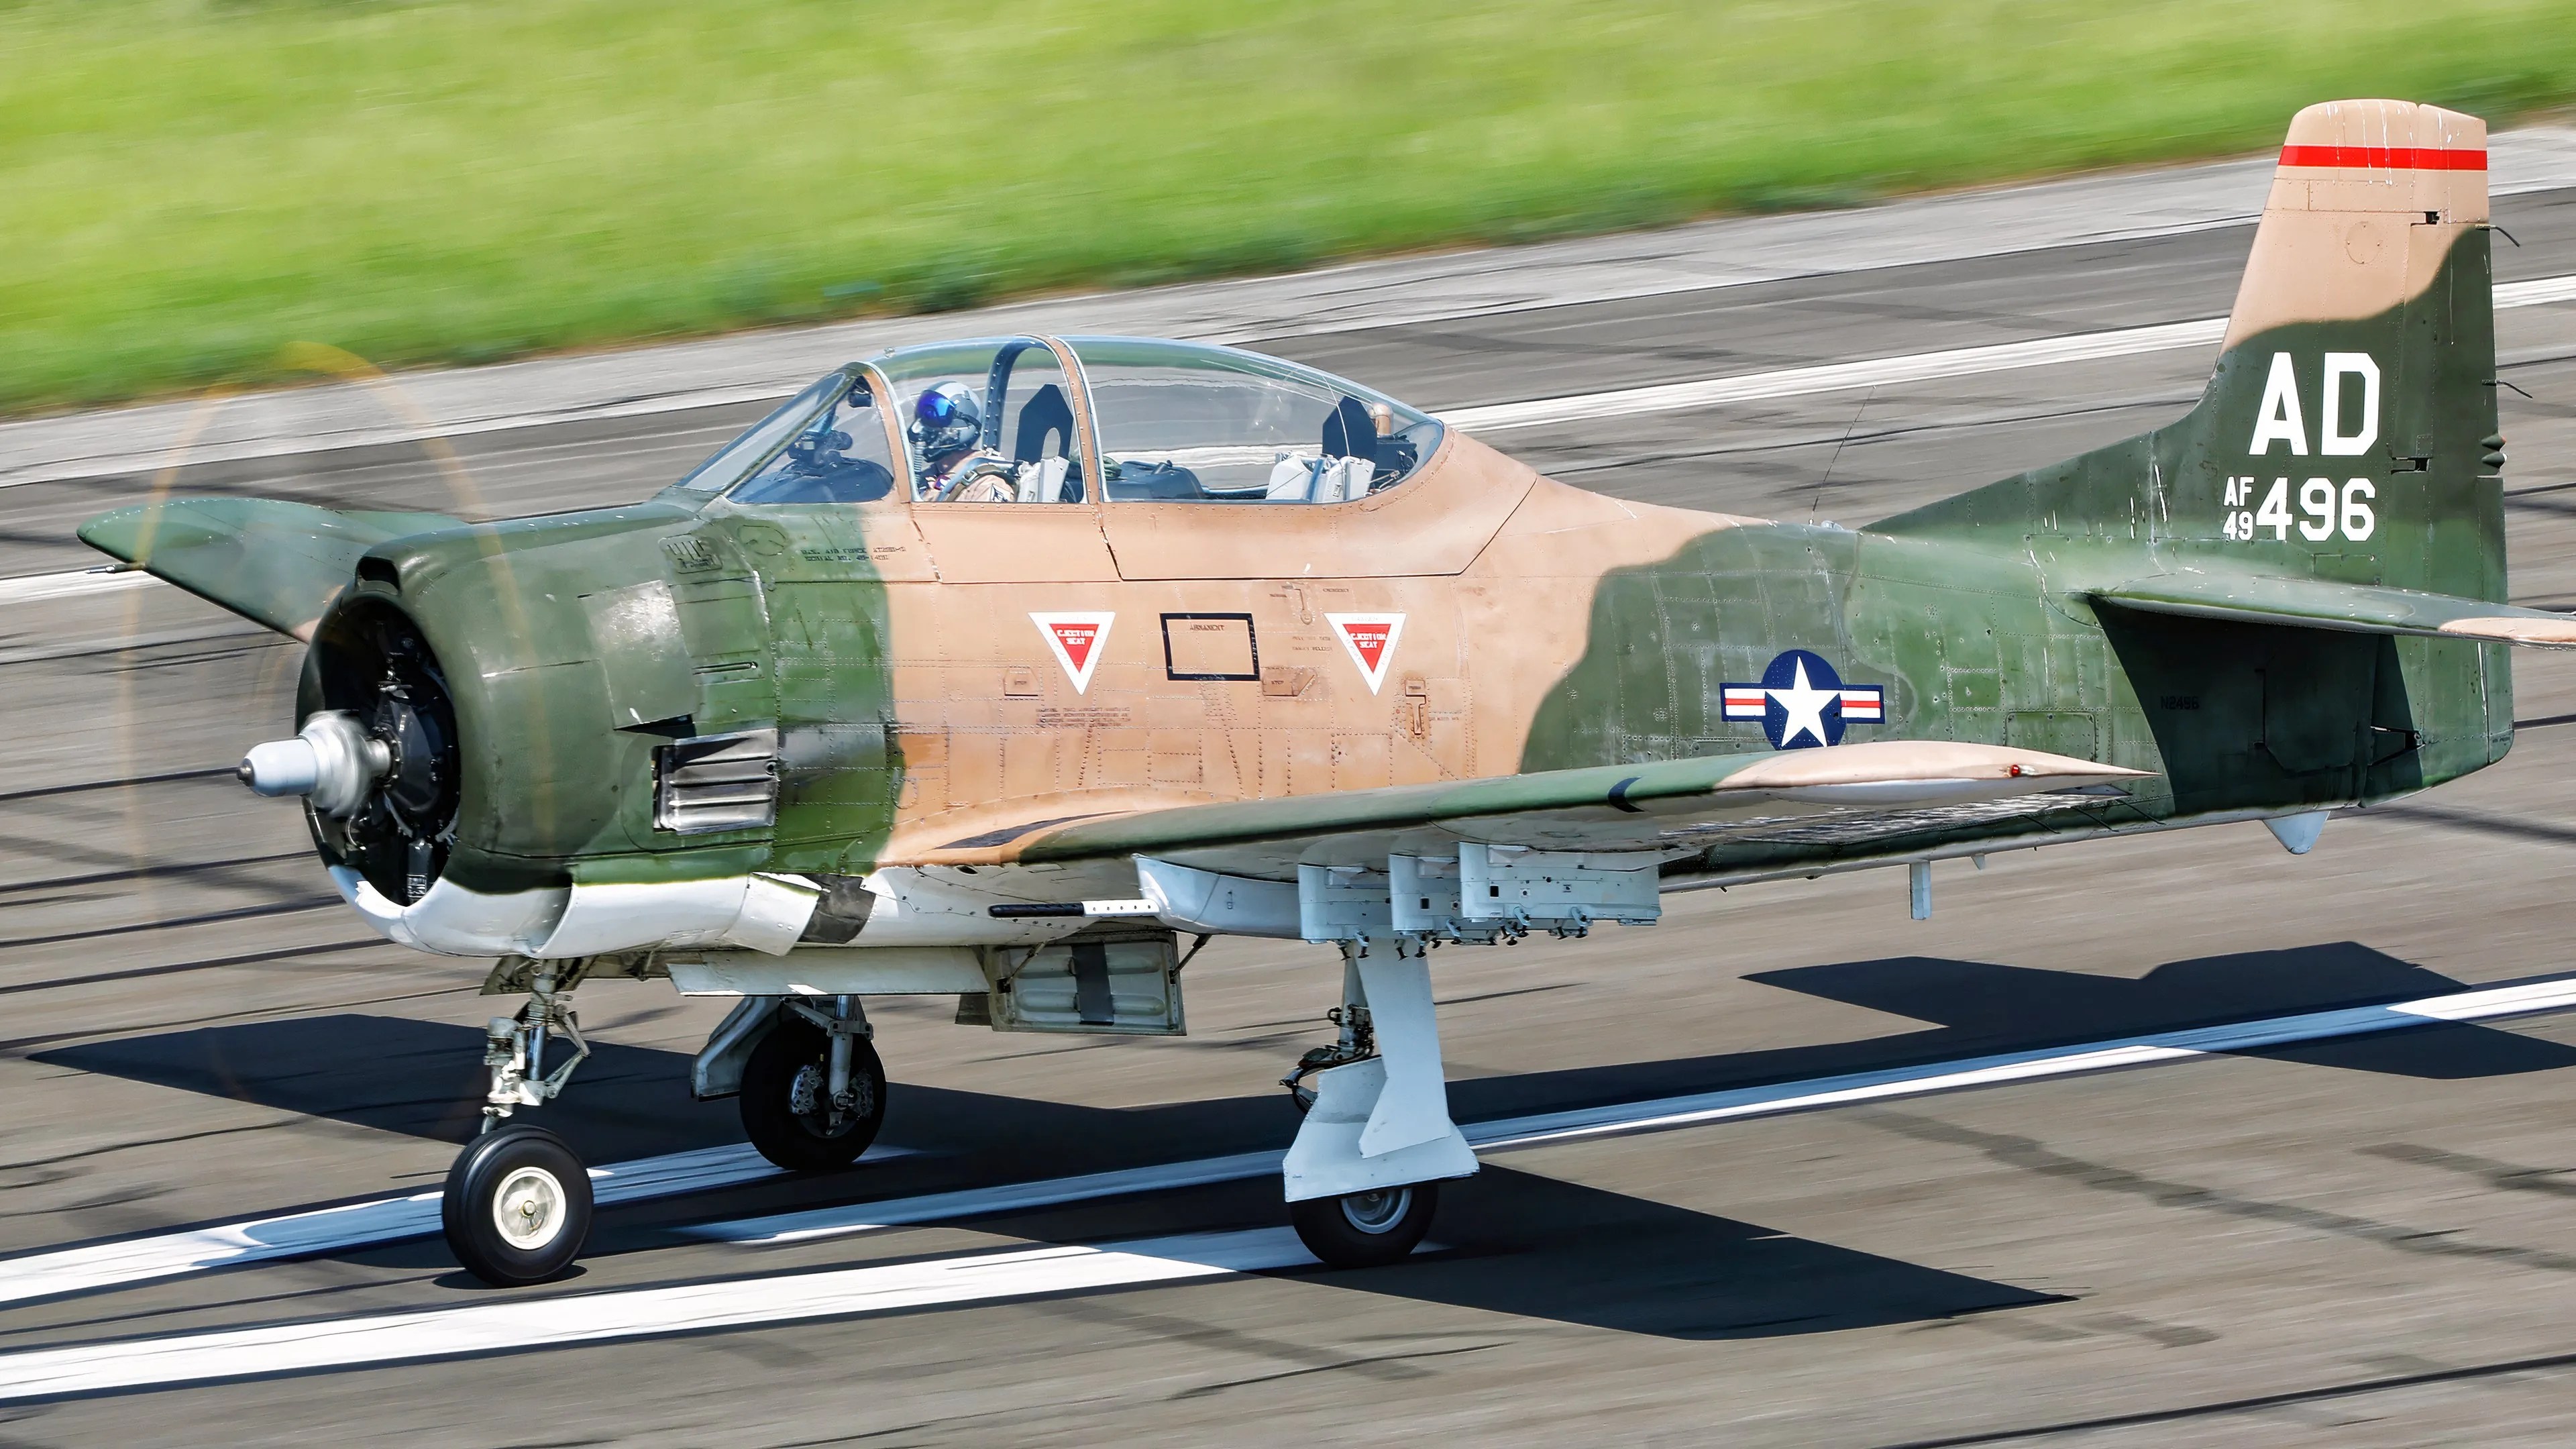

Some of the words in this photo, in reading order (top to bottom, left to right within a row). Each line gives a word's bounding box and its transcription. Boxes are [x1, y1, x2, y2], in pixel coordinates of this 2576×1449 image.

[2249, 352, 2381, 456] AD
[2223, 476, 2255, 506] AF
[2256, 477, 2376, 541] 496
[2222, 511, 2254, 541] 49
[1065, 637, 1086, 645] SEAT
[1359, 641, 1378, 649] SEAT
[2160, 696, 2200, 710] N2496
